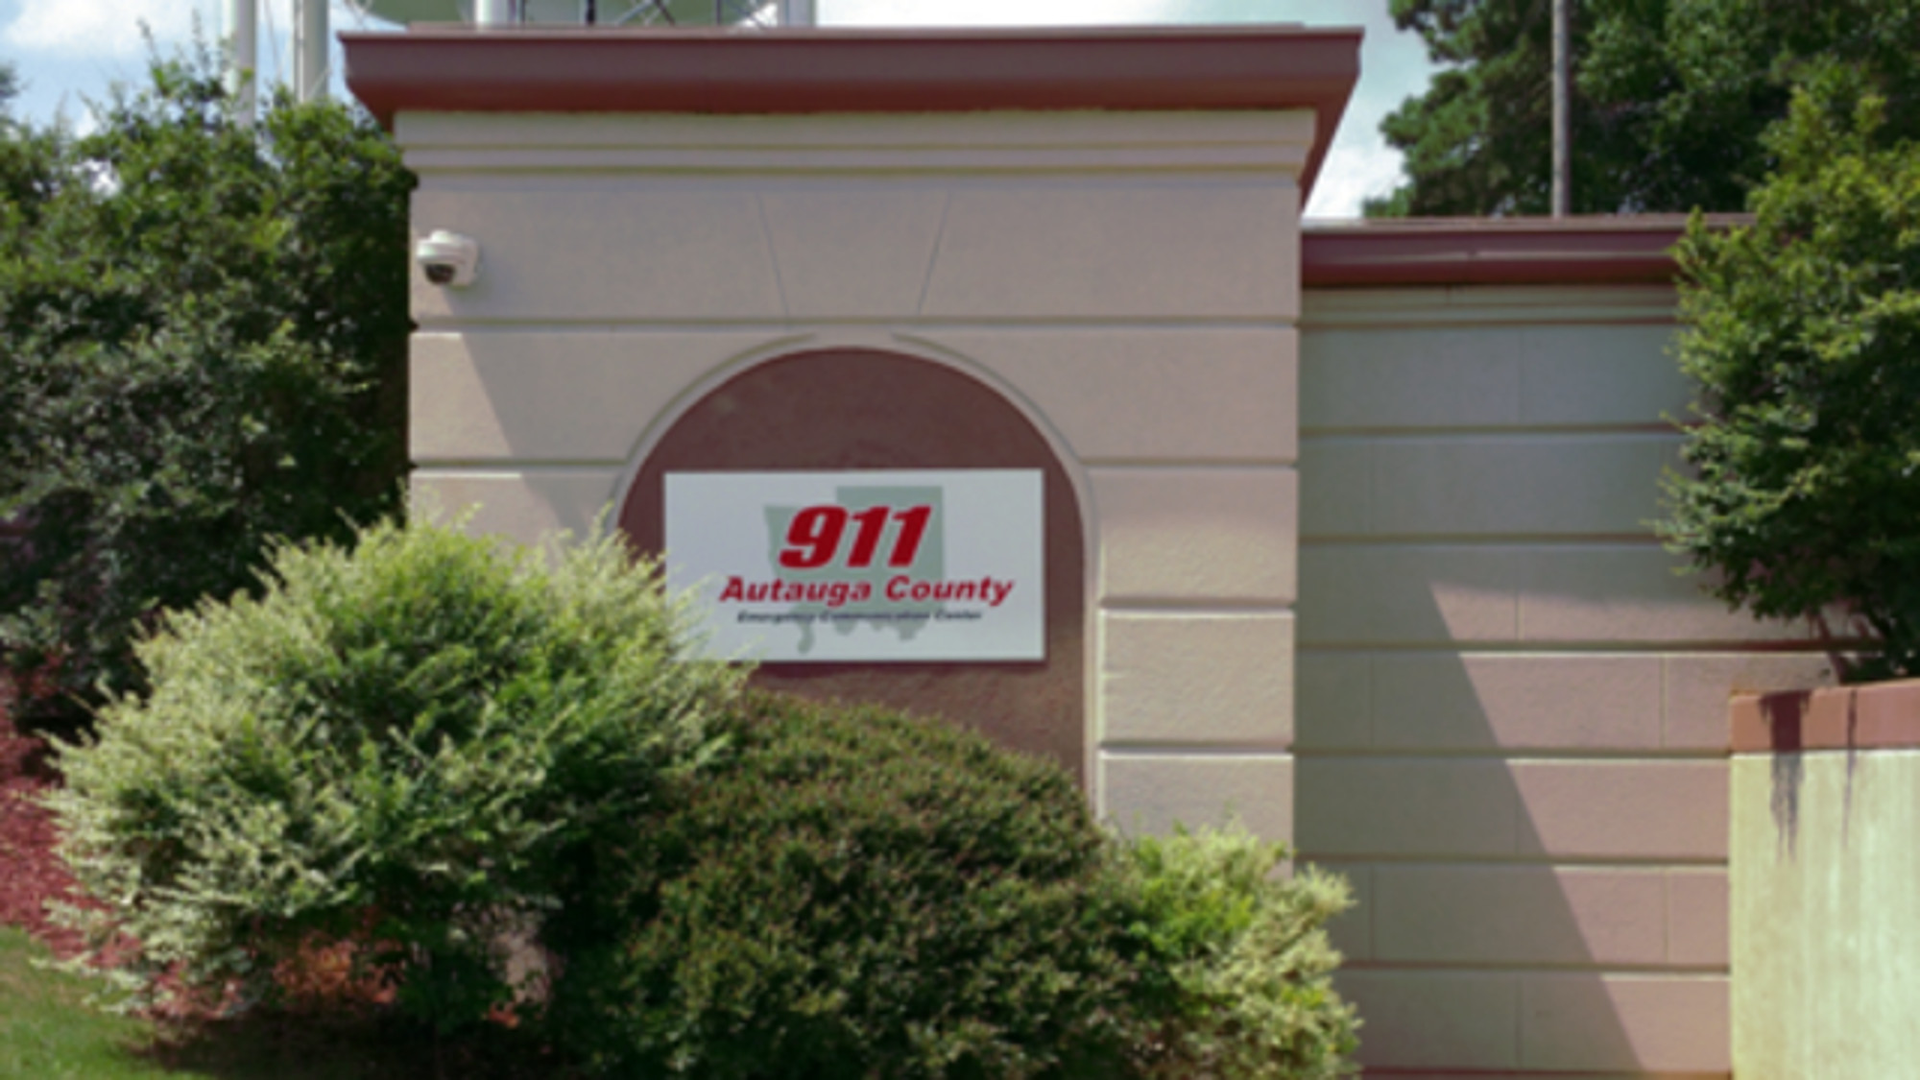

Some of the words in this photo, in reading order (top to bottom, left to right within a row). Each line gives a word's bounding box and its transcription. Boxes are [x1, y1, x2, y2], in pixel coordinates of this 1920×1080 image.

[778, 504, 932, 568] 911
[719, 575, 871, 607] Autauga
[885, 575, 1013, 606] County
